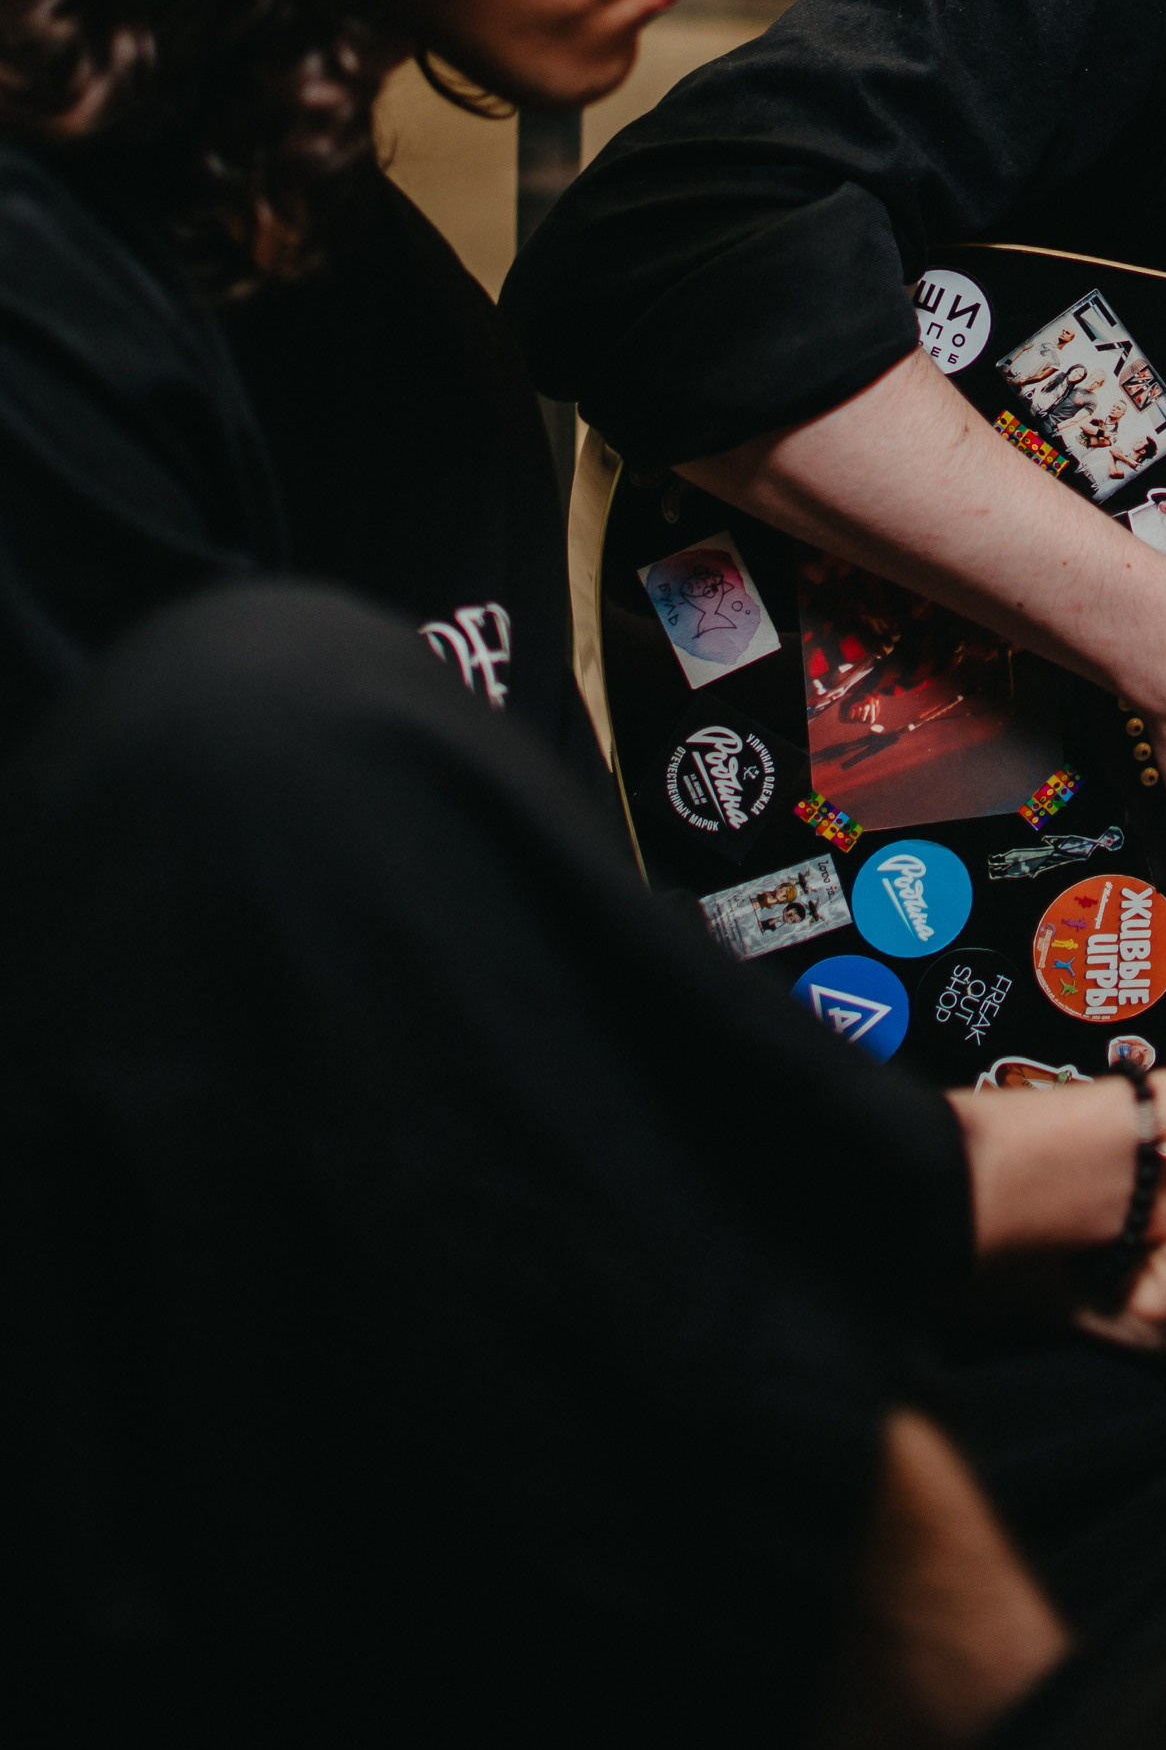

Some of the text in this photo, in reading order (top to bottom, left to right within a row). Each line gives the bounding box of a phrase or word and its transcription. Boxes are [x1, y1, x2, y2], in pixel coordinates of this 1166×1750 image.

[913, 280, 981, 329] ШИ
[926, 322, 965, 348] ПО
[666, 745, 691, 819] ОТЕЧЕСТВЕННЫХ
[688, 813, 720, 831] МАРОК
[685, 725, 749, 830] Родина
[746, 733, 775, 816] УЛИЧНАЯ ОДЕЖДА
[818, 859, 831, 884] love
[877, 853, 935, 942] Родина
[1085, 933, 1119, 1015] ИГРЫ
[1118, 887, 1154, 1006] ЖИВЫЕ
[935, 964, 972, 1023] SHOP
[955, 979, 987, 1026] OUT
[965, 973, 1013, 1046] FREAK
